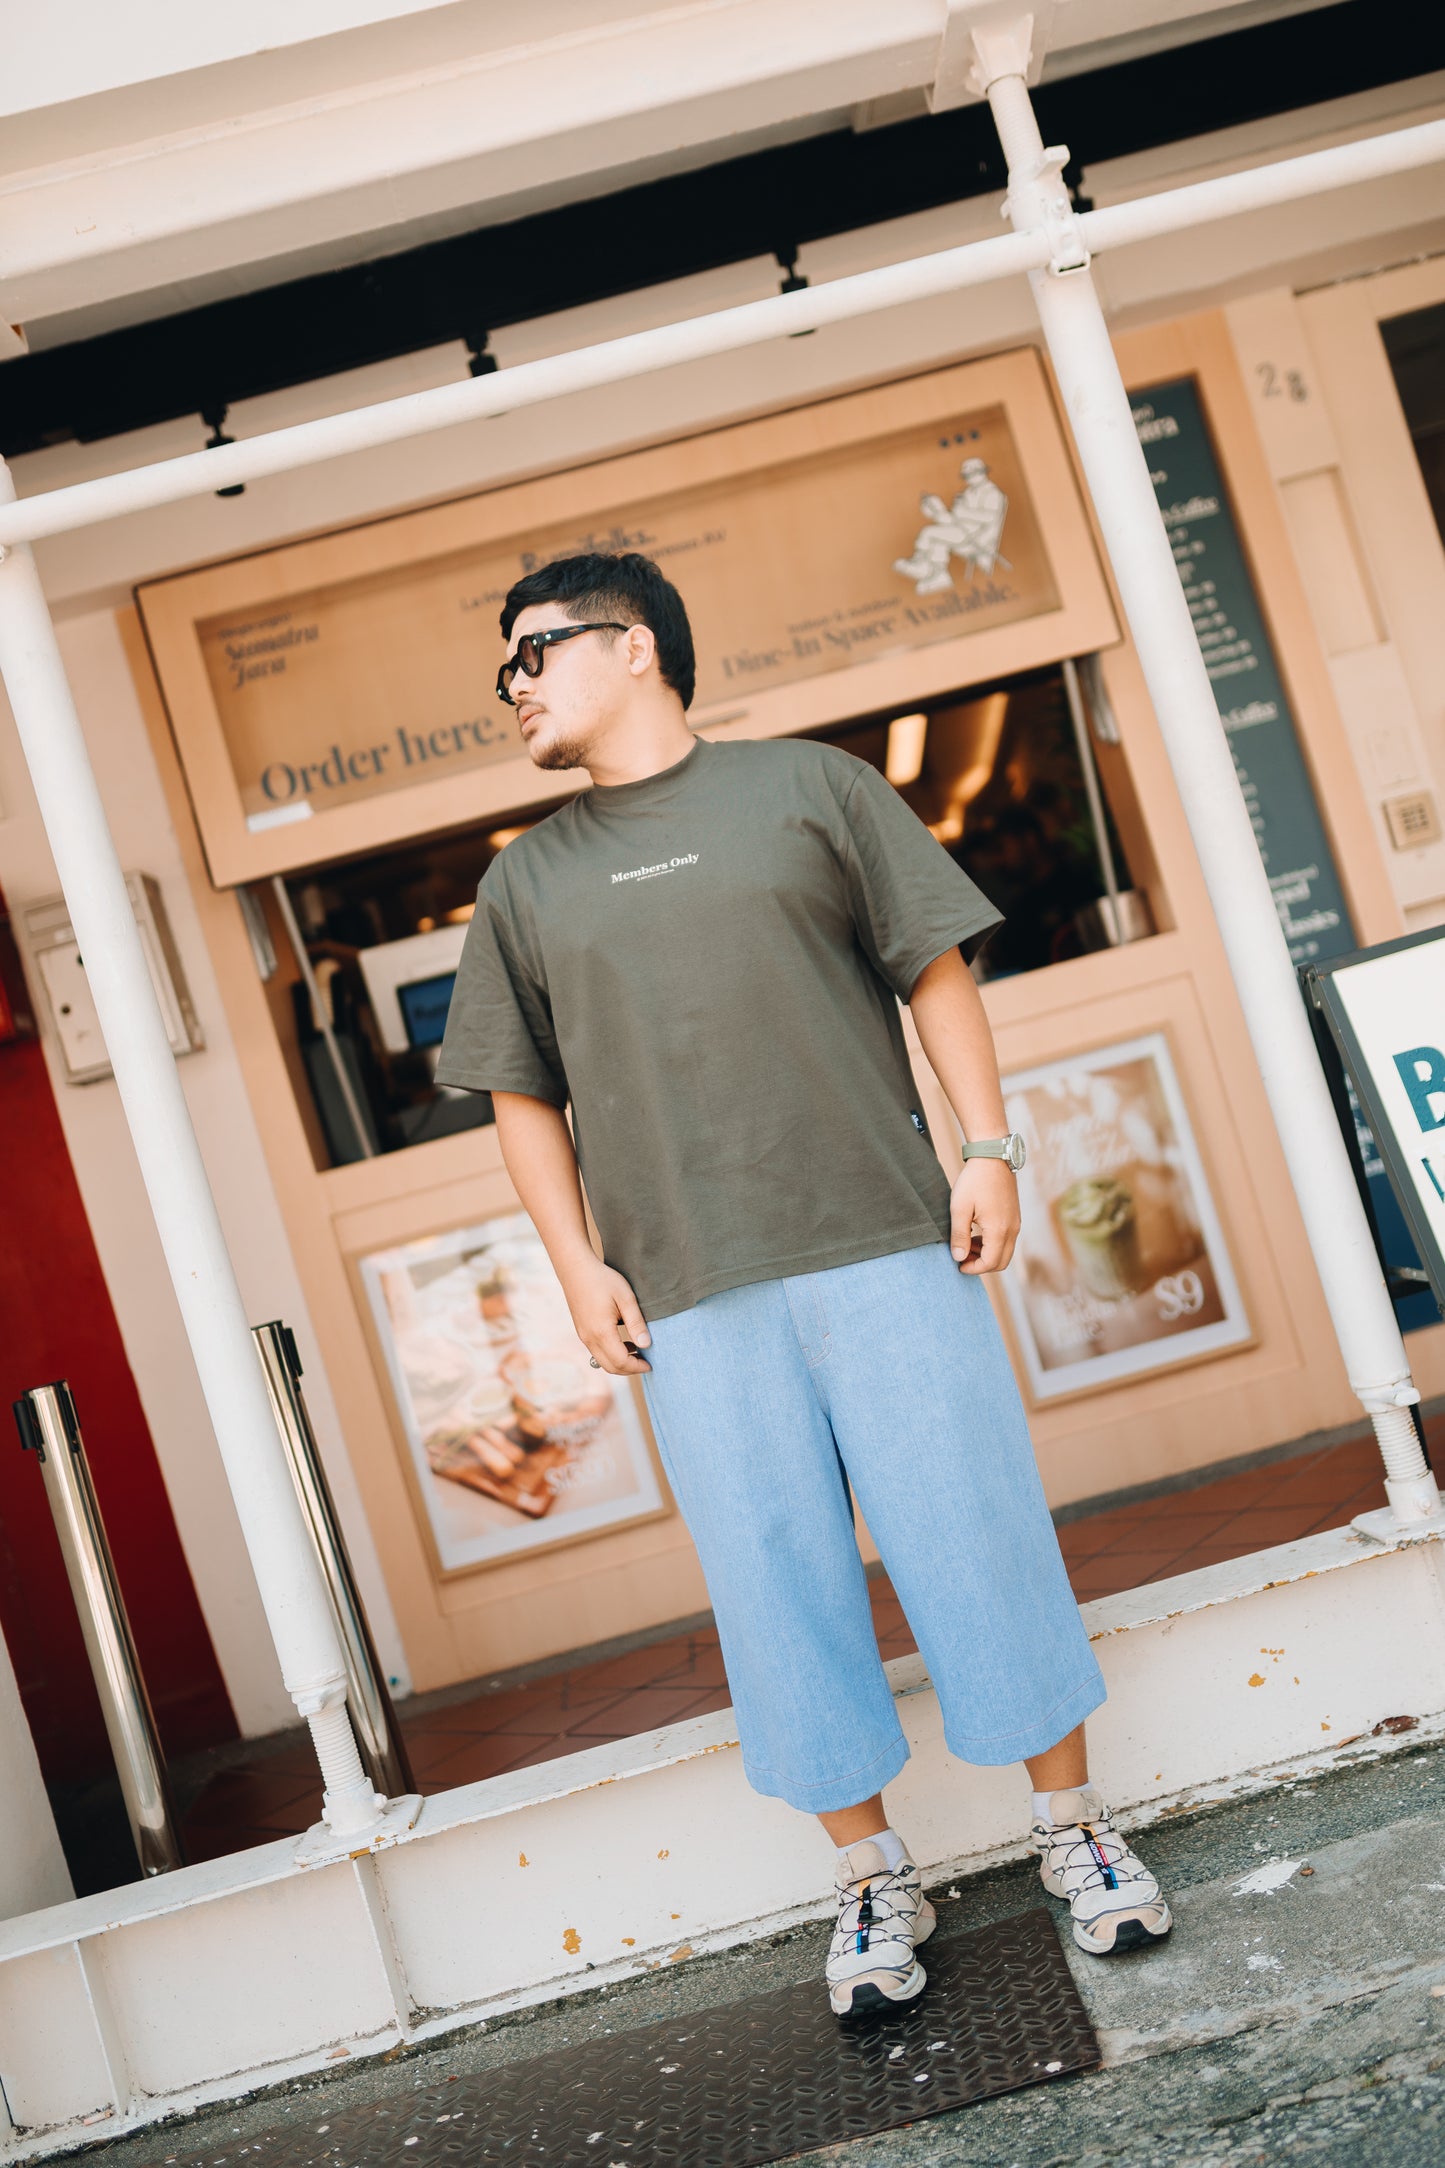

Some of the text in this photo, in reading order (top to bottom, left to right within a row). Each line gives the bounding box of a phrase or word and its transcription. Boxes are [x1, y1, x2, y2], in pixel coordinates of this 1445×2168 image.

[824, 616, 897, 651] Space
[261, 715, 508, 801] Order here.
[610, 862, 668, 884] Members
[670, 853, 699, 868] Only
[1087, 1840, 1110, 1875] SOMON
